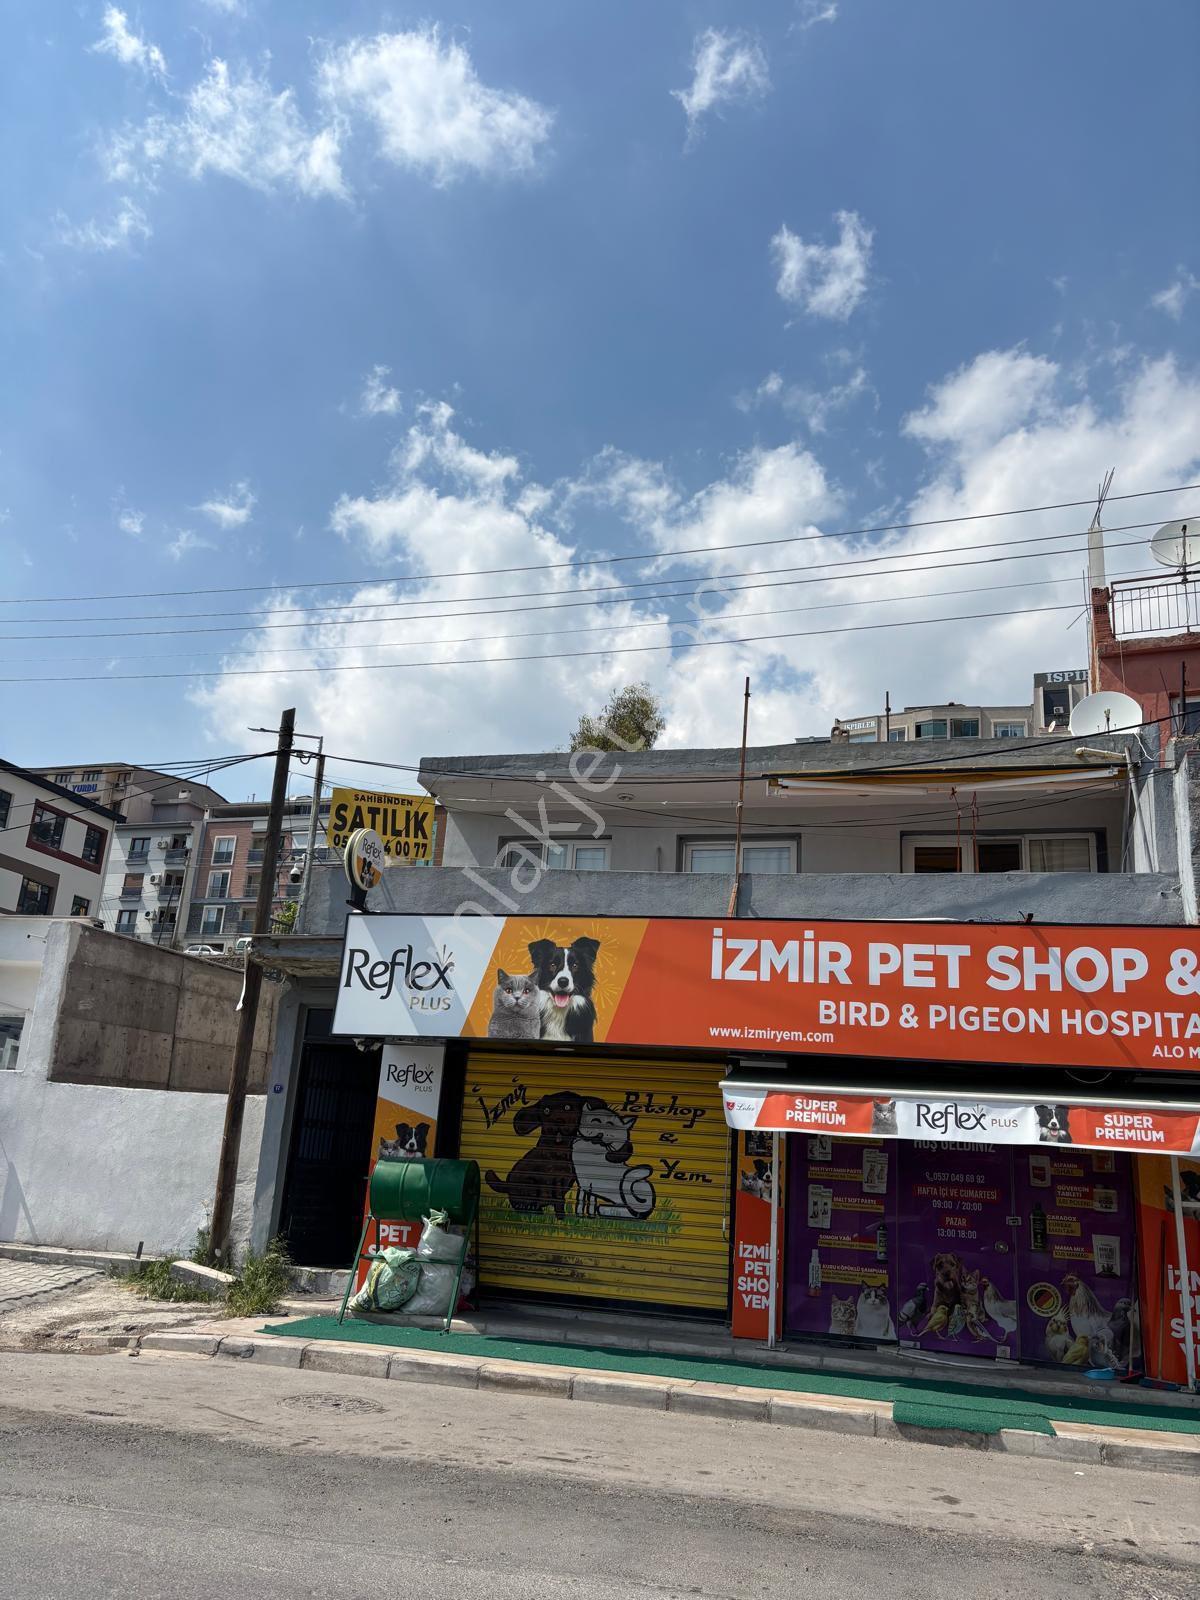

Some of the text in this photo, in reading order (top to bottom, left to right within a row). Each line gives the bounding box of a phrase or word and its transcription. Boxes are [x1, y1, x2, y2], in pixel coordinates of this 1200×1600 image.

[333, 803, 429, 840] SATILIK
[384, 840, 391, 856] 4
[395, 841, 410, 857] 00
[414, 842, 428, 858] 77
[711, 928, 1200, 995] İZMİR PET SHOP &
[344, 944, 455, 999] Reflex
[410, 996, 451, 1010] PLUS
[819, 1000, 1200, 1039] BIRD & PIGEON HOSPITA
[709, 1026, 834, 1043] www.izmiryem.com
[1152, 1045, 1184, 1058] ALO
[386, 1063, 435, 1087] Reflex
[795, 1098, 838, 1112] SUPER
[786, 1110, 846, 1125] PREMIUM
[916, 1102, 988, 1134] Reflex
[991, 1118, 1018, 1128] PLUS
[1104, 1114, 1153, 1129] SUPER
[1095, 1128, 1165, 1143] PREMIUM
[659, 1158, 713, 1184] Yem
[945, 1216, 968, 1227] PAZAR
[380, 1224, 411, 1243] PET
[738, 1240, 779, 1261] İZMİ
[737, 1276, 779, 1293] SHO
